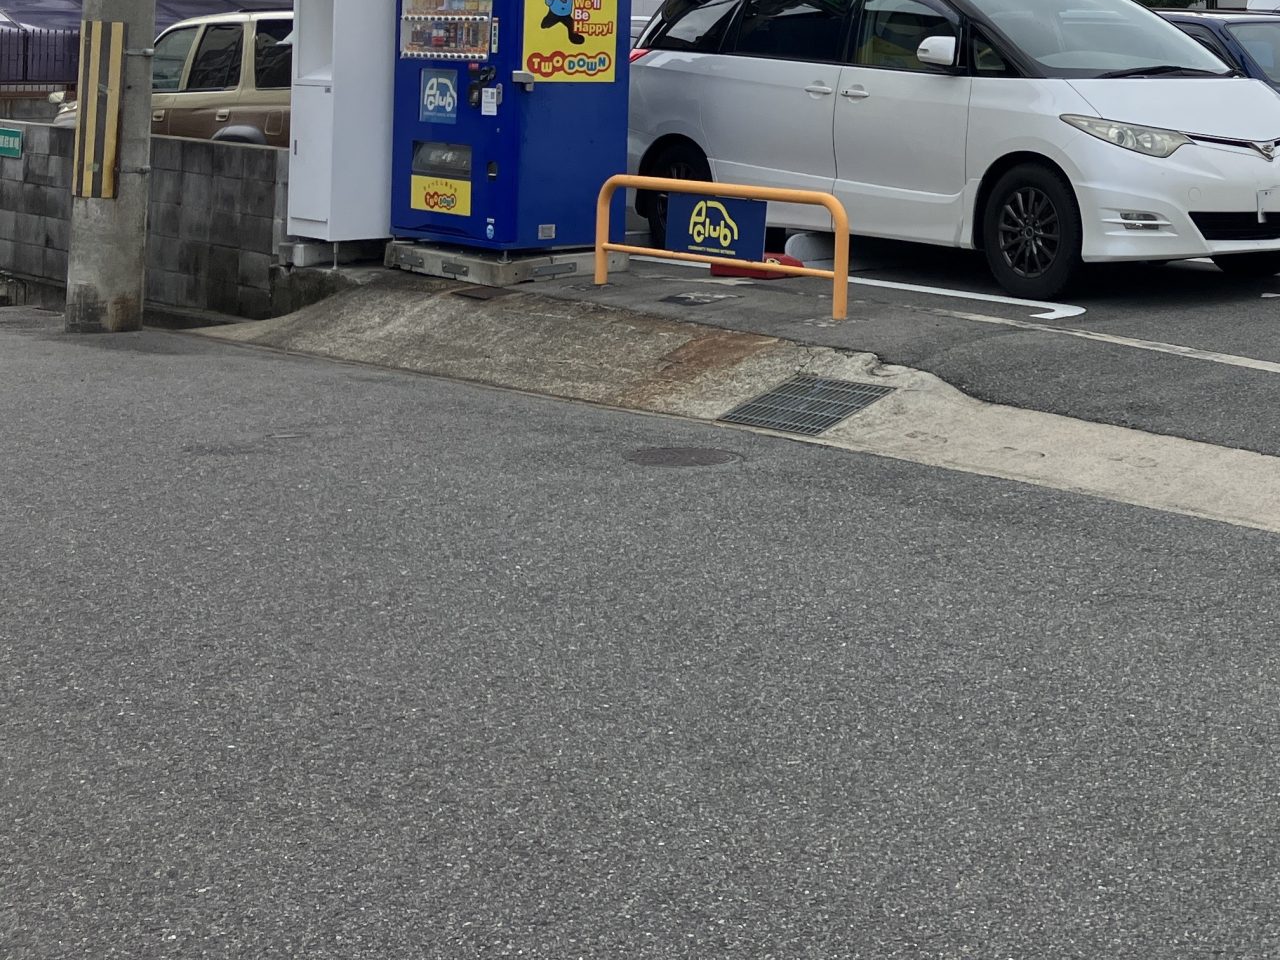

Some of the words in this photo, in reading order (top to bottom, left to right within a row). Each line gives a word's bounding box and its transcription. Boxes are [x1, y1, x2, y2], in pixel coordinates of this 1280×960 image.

[574, 9, 590, 21] Be
[573, 21, 614, 35] Happy!
[532, 56, 563, 73] TWO
[567, 57, 607, 72] DOWN
